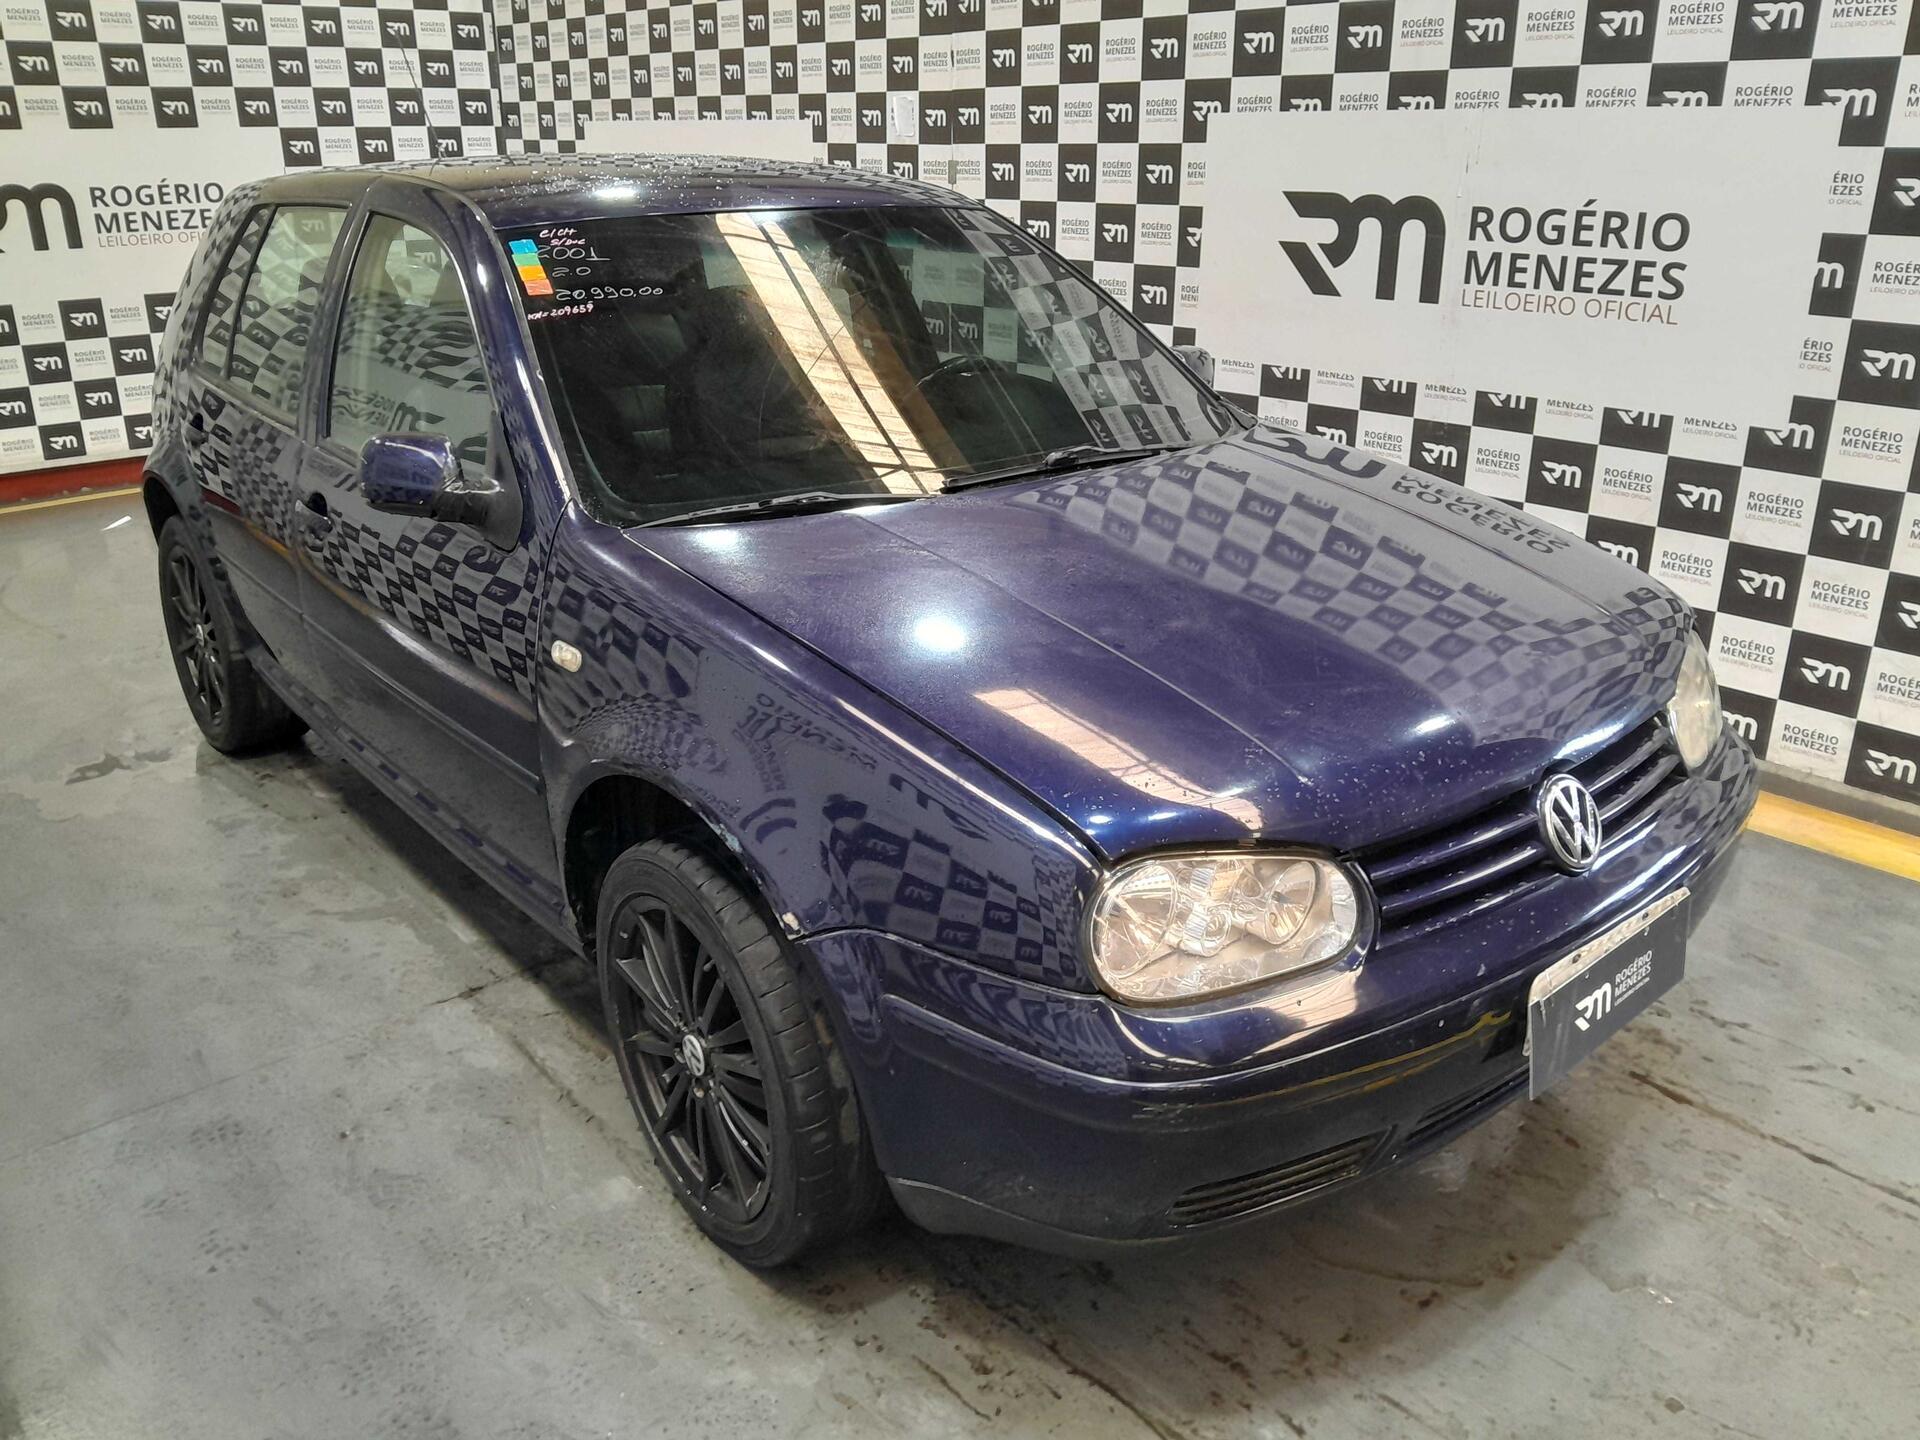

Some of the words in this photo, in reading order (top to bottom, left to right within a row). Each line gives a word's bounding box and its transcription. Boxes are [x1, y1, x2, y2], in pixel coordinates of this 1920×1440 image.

[1669, 0, 1724, 13] ROGÉRIO
[1832, 3, 1897, 17] MENEZES
[1527, 8, 1576, 20] ROGÉRIO
[1668, 13, 1723, 25] MENEZES
[1402, 16, 1445, 28] ROGÉRIO
[1526, 20, 1575, 32] MENEZES
[1290, 35, 1328, 45] MENEZES
[1401, 27, 1444, 39] MENEZES
[1106, 47, 1135, 56] MENEZES
[1193, 41, 1226, 51] MENEZES
[1027, 52, 1054, 60] MENEZES
[1455, 88, 1499, 100] ROGÉRIO
[1586, 86, 1636, 97] ROGÉRIO
[1734, 83, 1793, 96] ROGÉRIO
[1064, 110, 1092, 118] MENEZES
[1146, 108, 1177, 116] MENEZES
[1102, 170, 1131, 178] MENEZES
[89, 178, 225, 208] ROGÉRIO
[94, 208, 214, 234] MENEZE
[1467, 199, 1690, 252] ROGÉRIO
[1061, 227, 1088, 235] MENEZES
[1141, 231, 1171, 240] MENEZES
[97, 231, 174, 248] LEILOEIRO
[536, 245, 611, 261] 2001
[552, 266, 591, 278] 2.0
[1463, 250, 1688, 301] MENEZES
[1461, 288, 1576, 317] LEILOEIRO
[1583, 298, 1679, 326] OFICIAL
[1364, 431, 1403, 443] ROGÉRIO
[1842, 426, 1903, 442] ROGÉRIO
[1364, 439, 1403, 452] MENEZES
[1840, 437, 1902, 454] MENEZES
[1478, 448, 1521, 462] ROGÉRIO
[1477, 457, 1520, 471] MENEZES
[1604, 468, 1653, 483] ROGÉRIO
[1603, 477, 1652, 494] MENEZES
[1748, 491, 1803, 508] ROGÉRIO
[1746, 501, 1802, 519] MENEZES
[1662, 550, 1713, 568] ROGÉRIO
[1660, 560, 1712, 578] MENEZES
[1812, 580, 1870, 599] ROGÉRIO
[1810, 590, 1869, 610] MENEZES
[1722, 636, 1775, 655] ROGÉRIO
[1720, 645, 1774, 666] MENEZES
[1784, 724, 1839, 745] ROGÉRIO
[1782, 733, 1838, 756] MENEZES
[1615, 950, 1652, 985] ROGÉRIO
[1615, 962, 1651, 997] MENEZES
